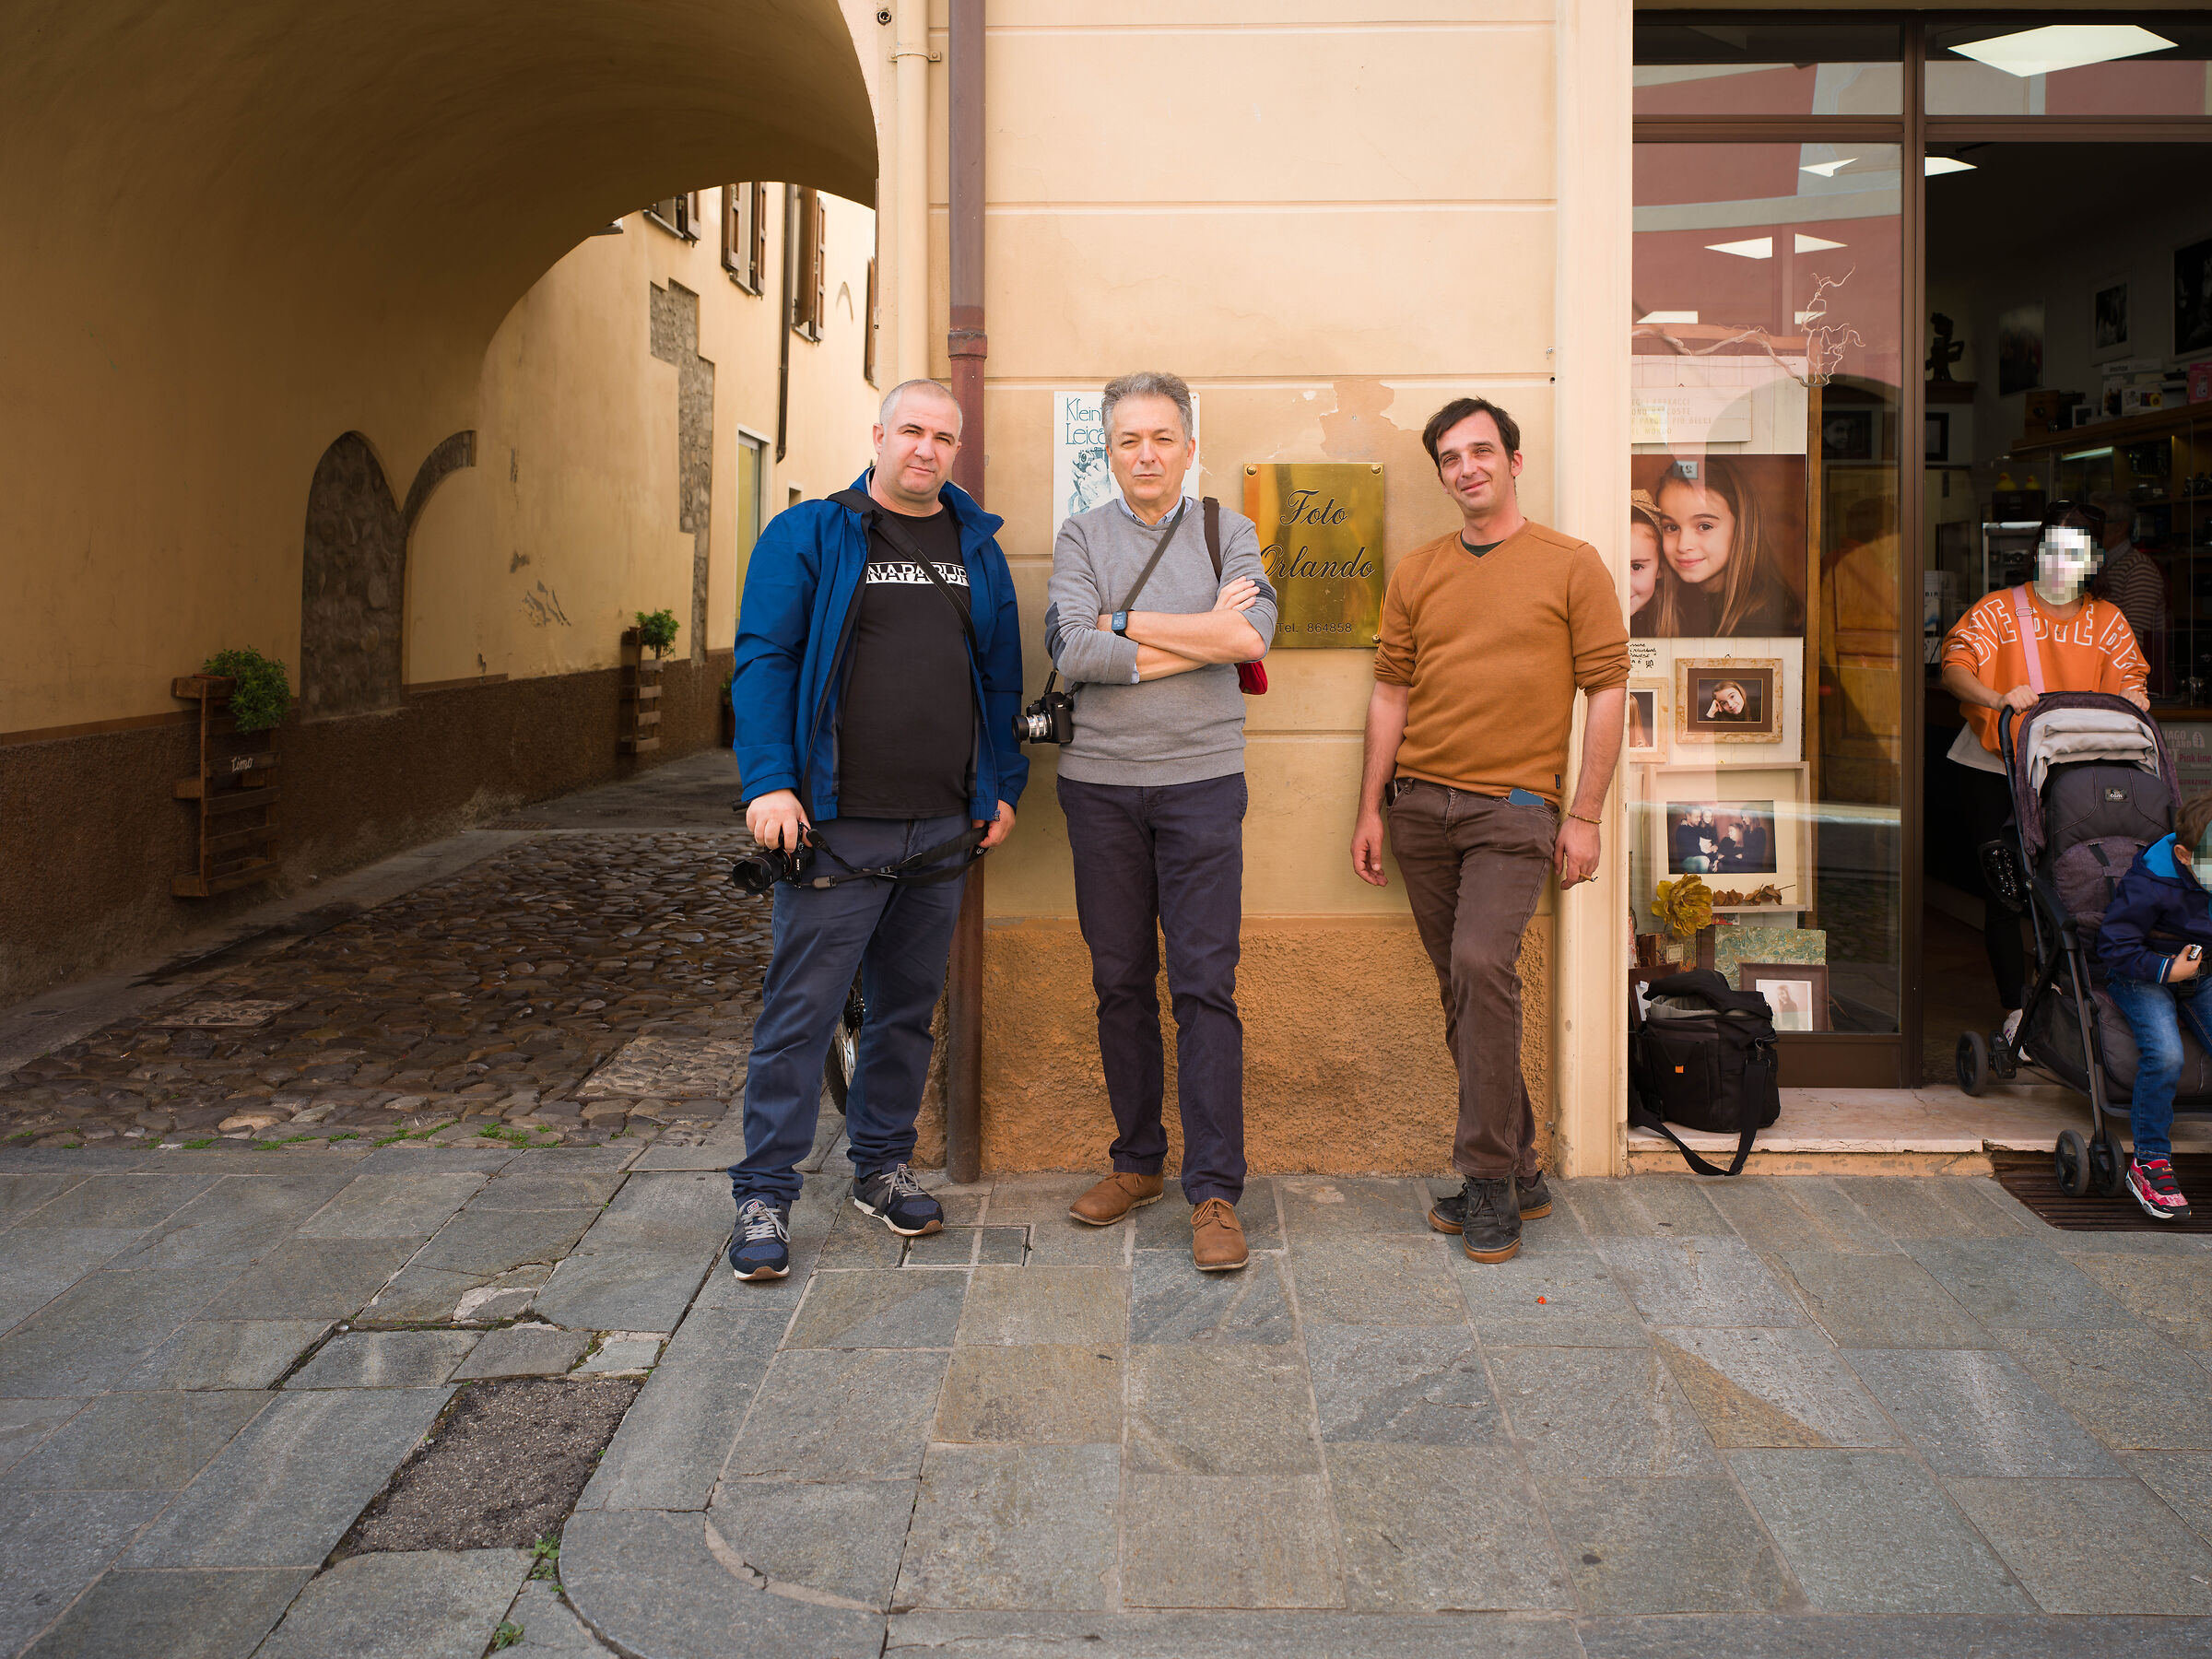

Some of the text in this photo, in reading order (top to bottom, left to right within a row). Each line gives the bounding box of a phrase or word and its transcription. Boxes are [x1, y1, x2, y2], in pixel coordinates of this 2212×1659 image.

[1065, 422, 1106, 445] Leica
[1279, 489, 1347, 525] Foto
[1261, 544, 1374, 578] Orlando
[1277, 622, 1352, 633] Tel. 864858
[2179, 753, 2196, 763] Pink
